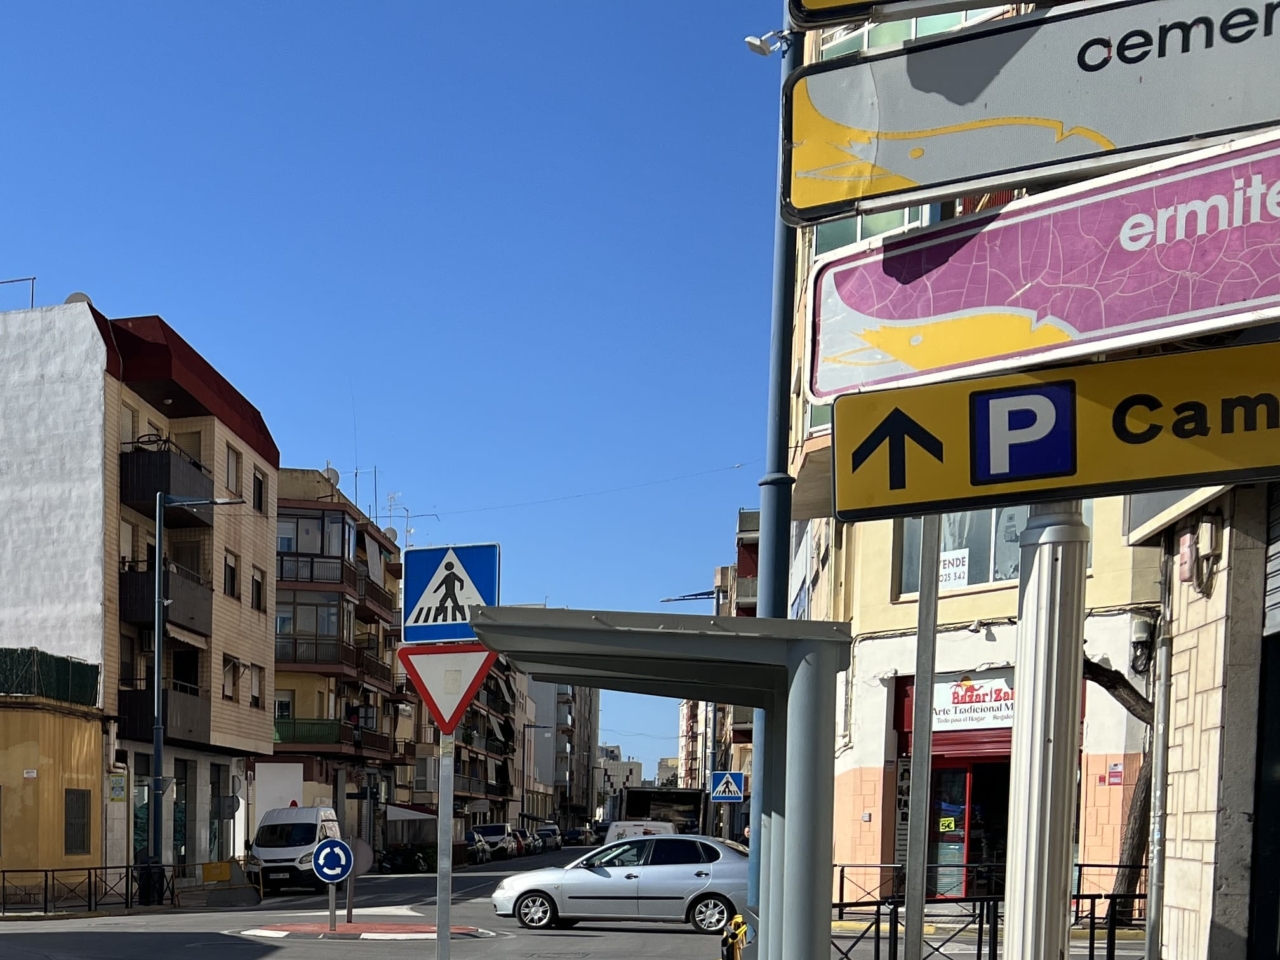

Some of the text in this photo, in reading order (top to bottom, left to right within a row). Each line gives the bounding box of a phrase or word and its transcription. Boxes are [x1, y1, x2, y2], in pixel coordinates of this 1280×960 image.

[989, 392, 1280, 475] P Cam
[952, 691, 989, 704] Bazar
[932, 707, 951, 716] Arte
[952, 703, 1002, 715] Tradicional
[941, 821, 954, 830] 5€
